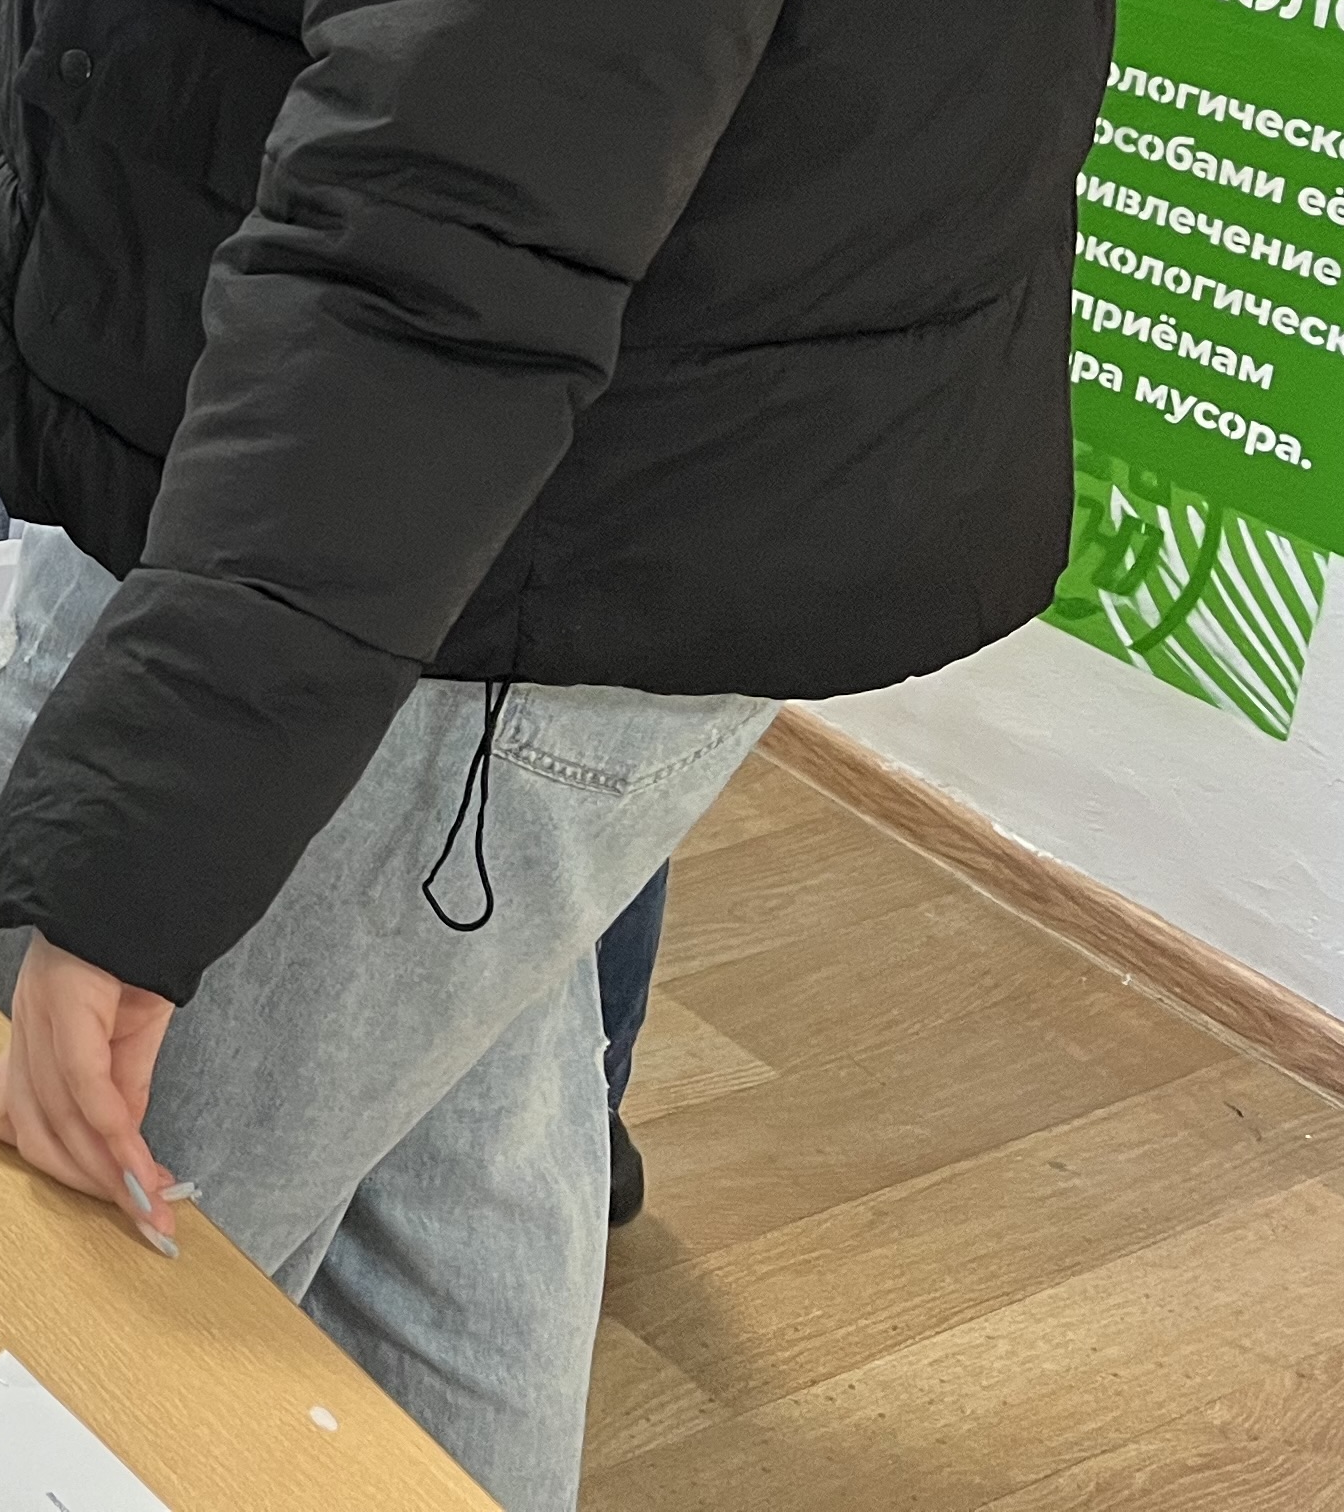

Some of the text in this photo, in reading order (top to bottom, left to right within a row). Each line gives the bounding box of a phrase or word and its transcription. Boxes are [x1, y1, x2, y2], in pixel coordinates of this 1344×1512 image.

[1071, 289, 1274, 391] приёмам
[1069, 350, 1312, 470] ра мусора.
